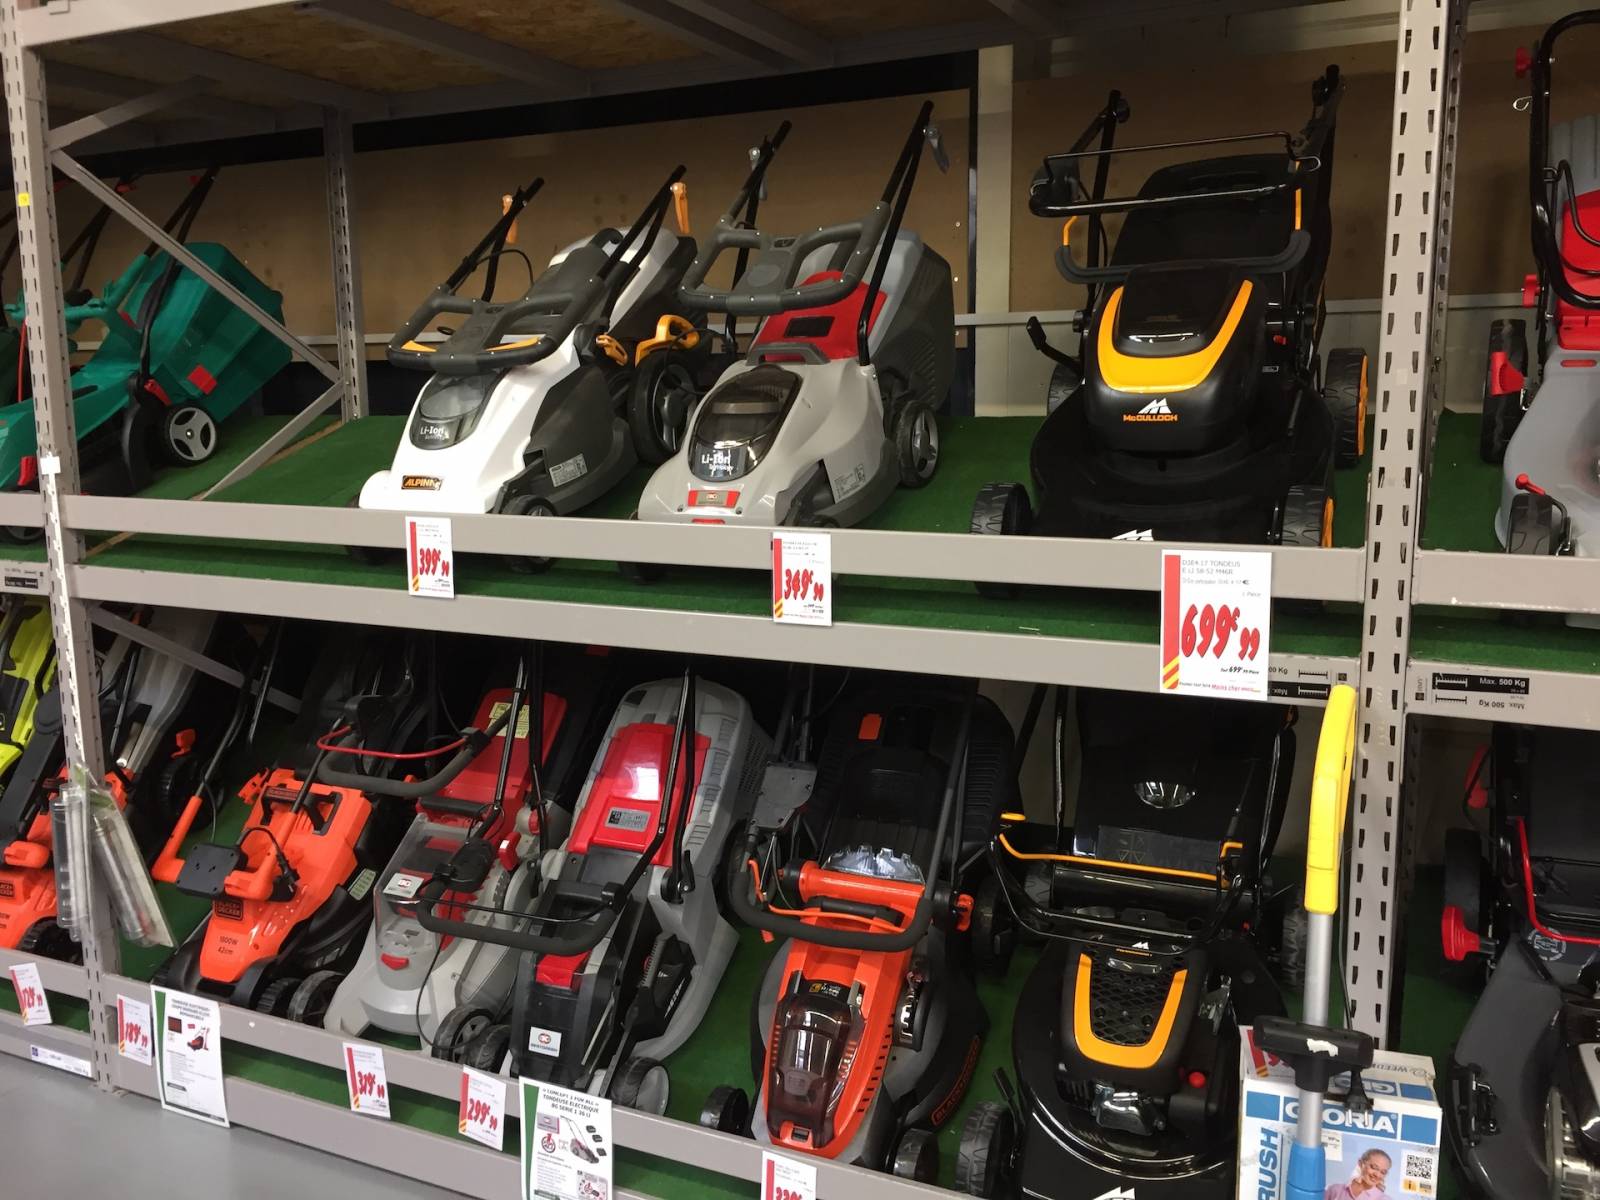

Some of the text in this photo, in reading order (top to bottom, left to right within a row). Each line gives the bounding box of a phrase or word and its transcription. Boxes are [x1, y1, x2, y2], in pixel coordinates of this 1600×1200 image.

[1123, 414, 1178, 422] McCULLOCH
[1182, 603, 1260, 661] 699€ 99
[1278, 667, 1288, 675] Kg
[1499, 678, 1513, 686] 500
[1514, 679, 1526, 688] Kg
[543, 1094, 599, 1113] TONDEUSE ELECTRIQUE
[1285, 1101, 1395, 1134] GORIA
